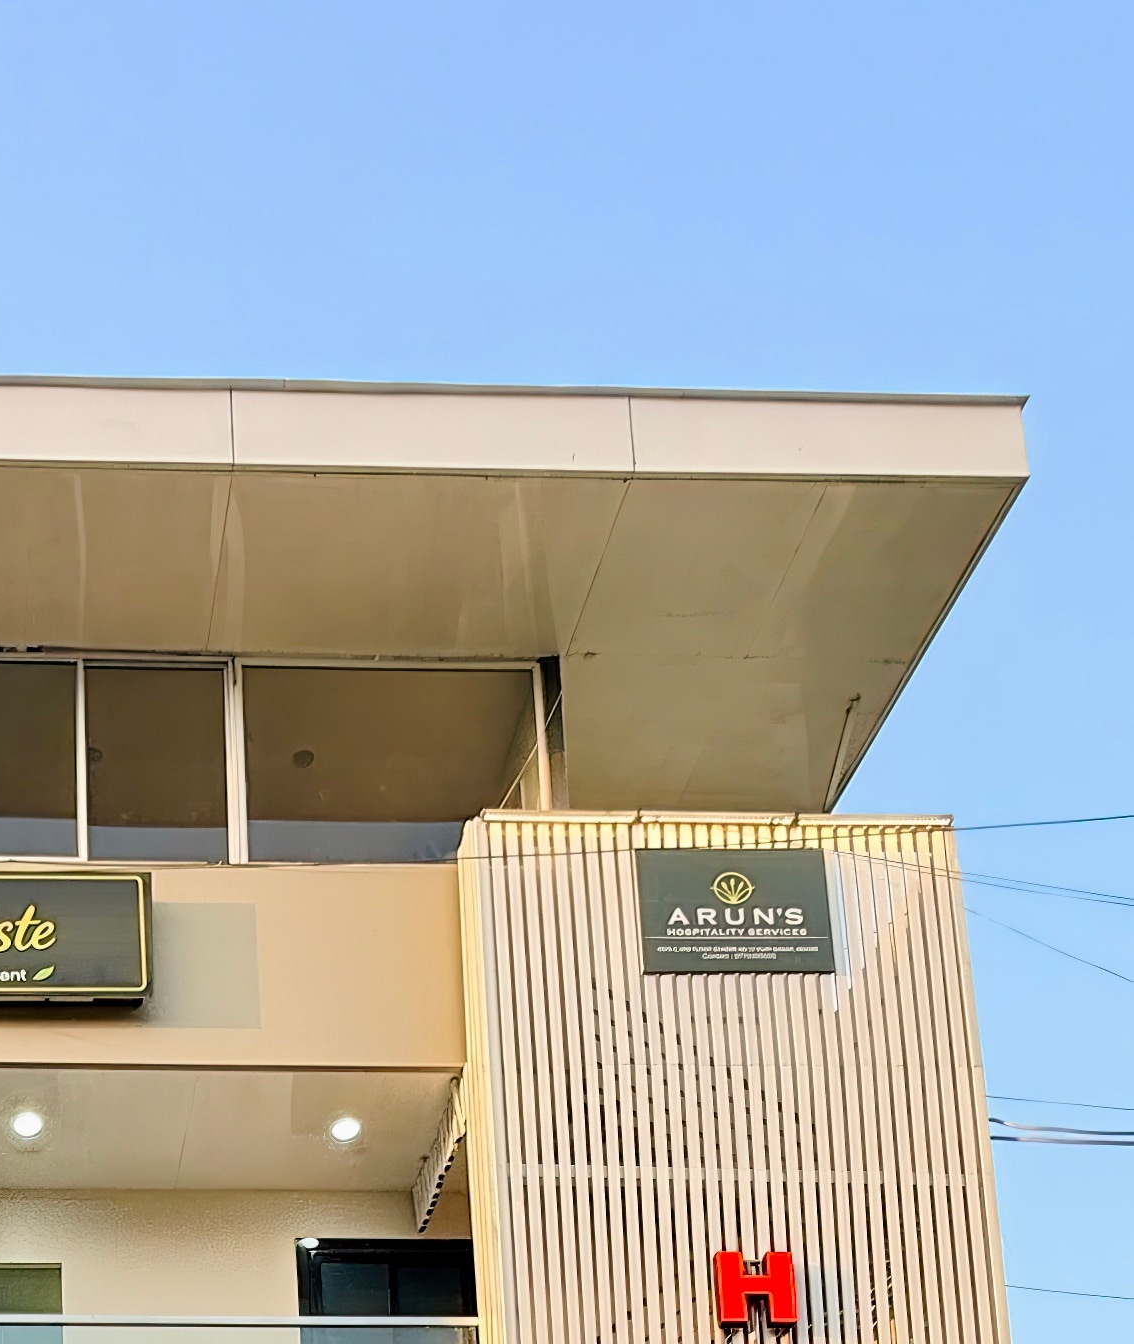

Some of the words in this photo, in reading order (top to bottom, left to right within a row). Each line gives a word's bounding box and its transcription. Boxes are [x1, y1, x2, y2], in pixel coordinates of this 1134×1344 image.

[667, 907, 804, 925] ARUN'S
[667, 928, 745, 936] HOSPITALITY
[748, 928, 807, 936] SERVICES
